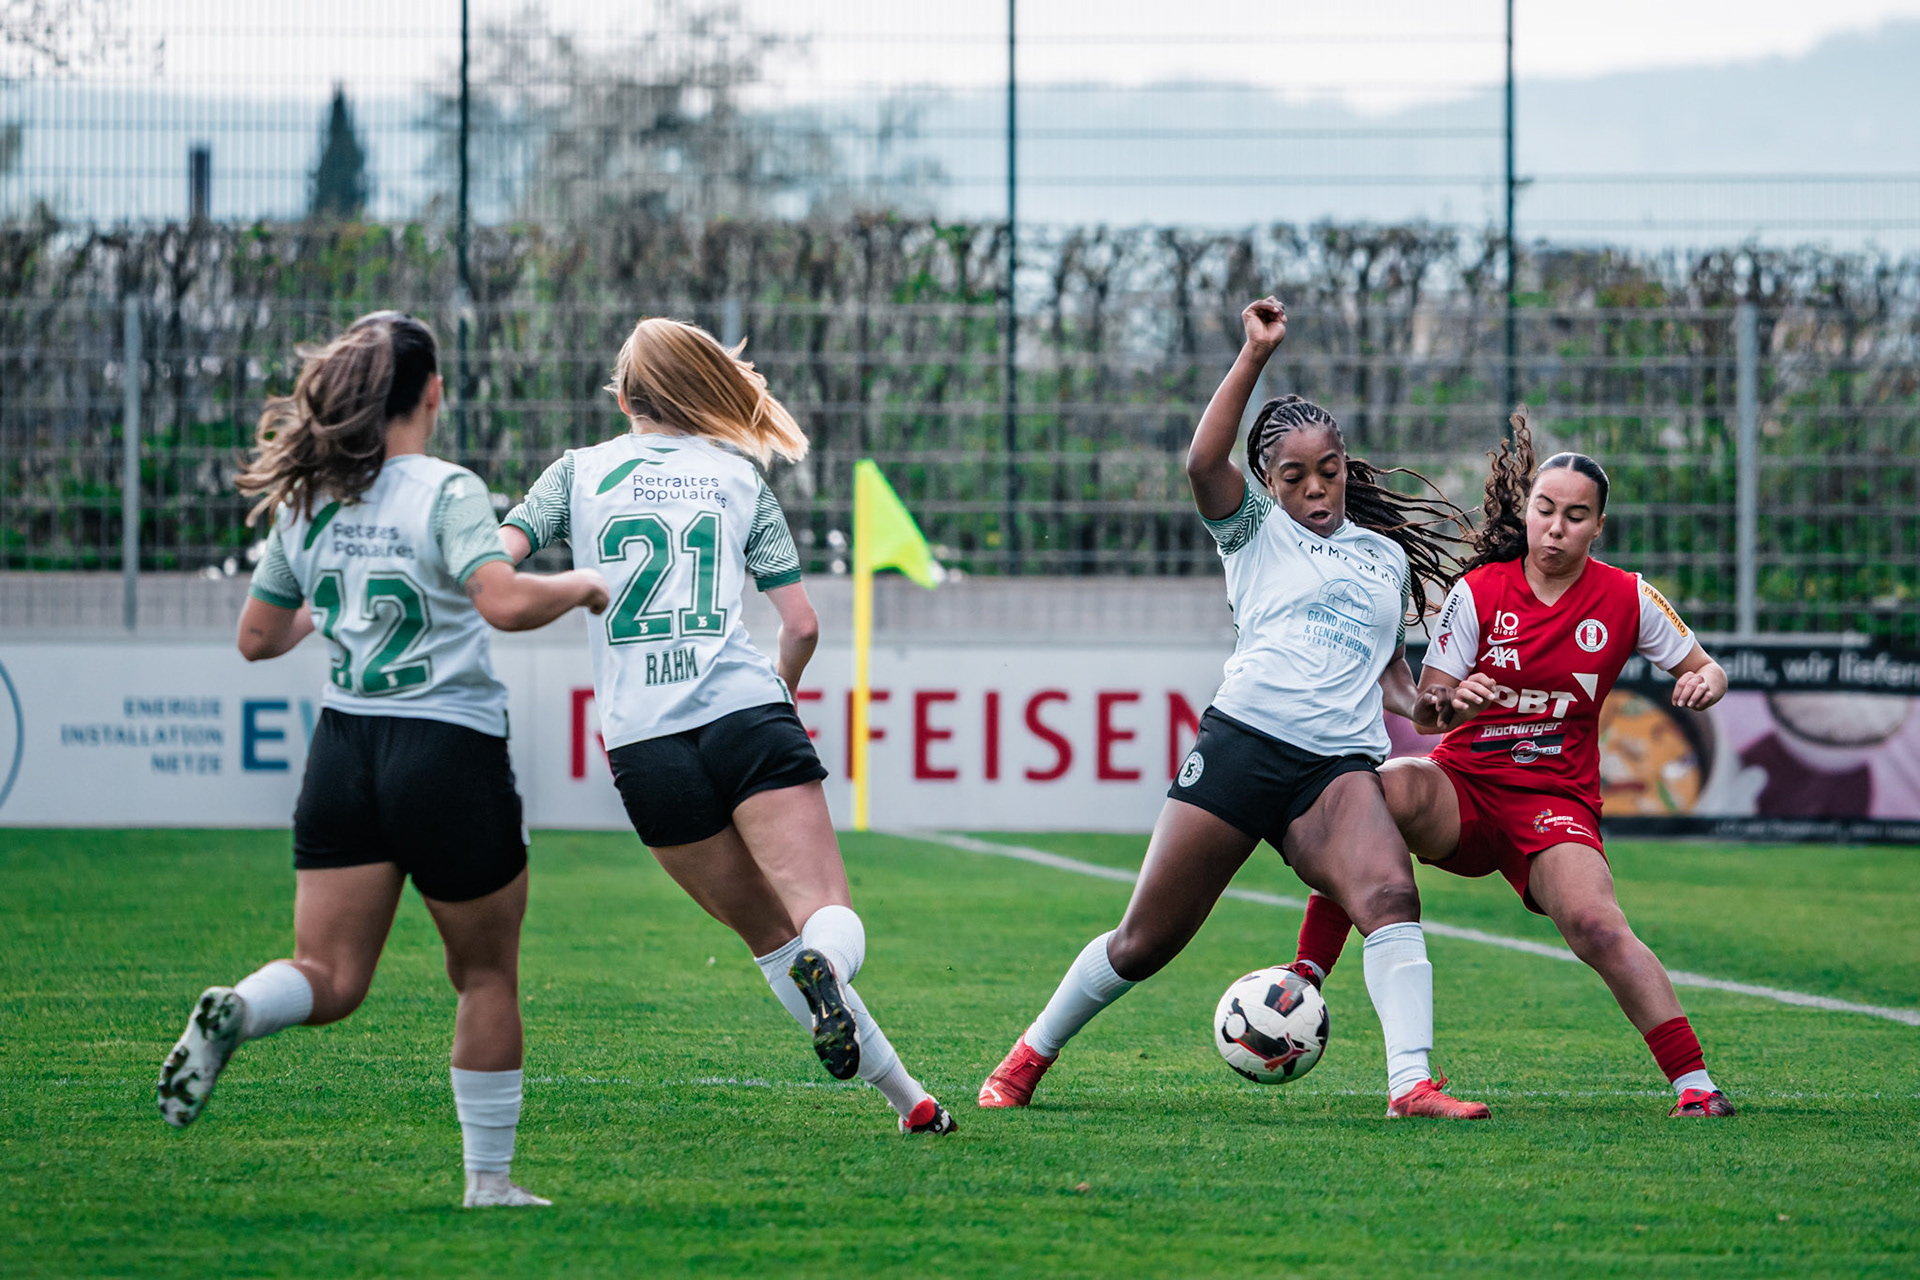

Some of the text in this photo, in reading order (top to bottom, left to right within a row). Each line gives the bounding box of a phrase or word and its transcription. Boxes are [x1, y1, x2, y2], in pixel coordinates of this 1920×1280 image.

[632, 474, 719, 488] Retraites
[633, 487, 727, 509] Populaires
[597, 510, 728, 646] 21
[1307, 609, 1338, 627] GRAND
[1494, 610, 1519, 630] 10
[1304, 624, 1311, 634] &
[1313, 625, 1345, 645] CENTRE
[1493, 627, 1518, 636] dieci
[645, 646, 699, 686] RAHM
[1480, 645, 1521, 671] AXA
[123, 697, 222, 719] ENERGIE
[1494, 685, 1578, 719] OBT
[60, 724, 223, 747] INSTALLATION
[150, 753, 222, 774] NETZE
